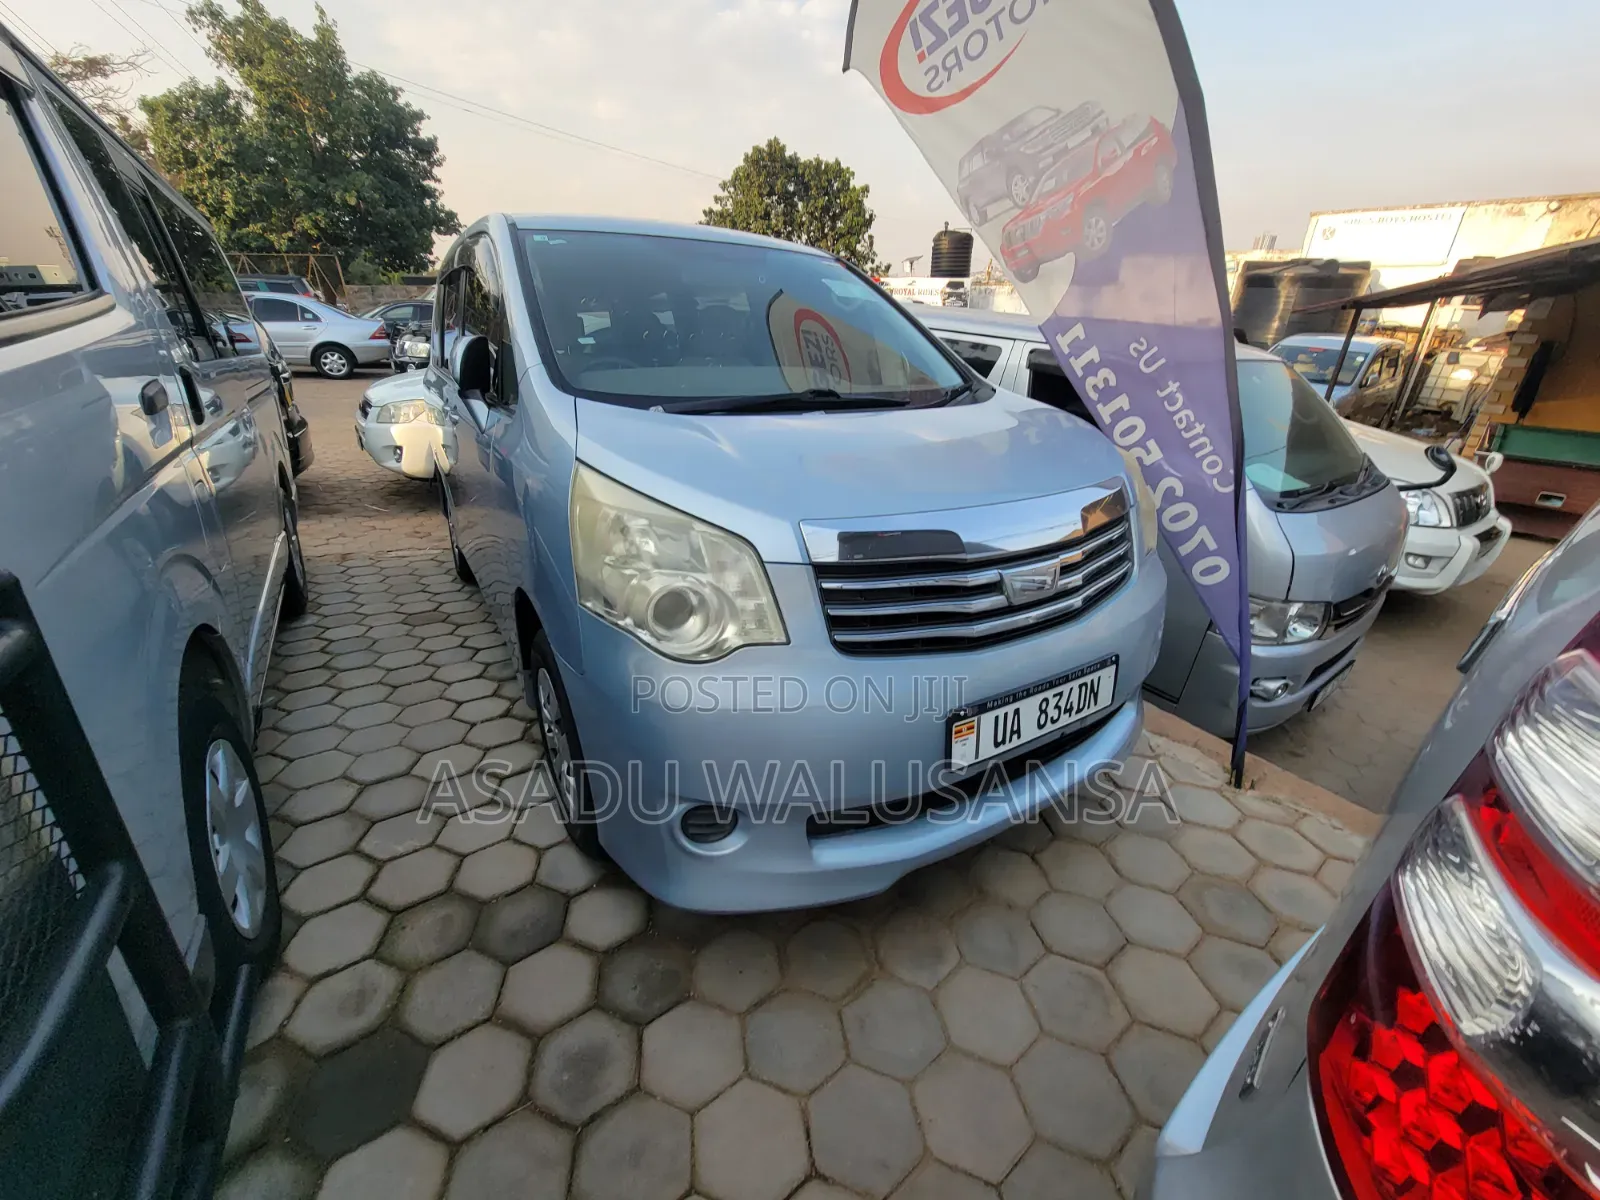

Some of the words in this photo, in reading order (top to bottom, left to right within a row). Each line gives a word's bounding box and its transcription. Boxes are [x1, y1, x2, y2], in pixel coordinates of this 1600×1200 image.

[893, 287, 916, 296] ROYAL
[917, 287, 940, 296] RIDES
[986, 694, 1014, 710] Making
[1029, 682, 1050, 695] Roads
[993, 707, 1022, 749] UA
[1037, 676, 1101, 730] 834DN
